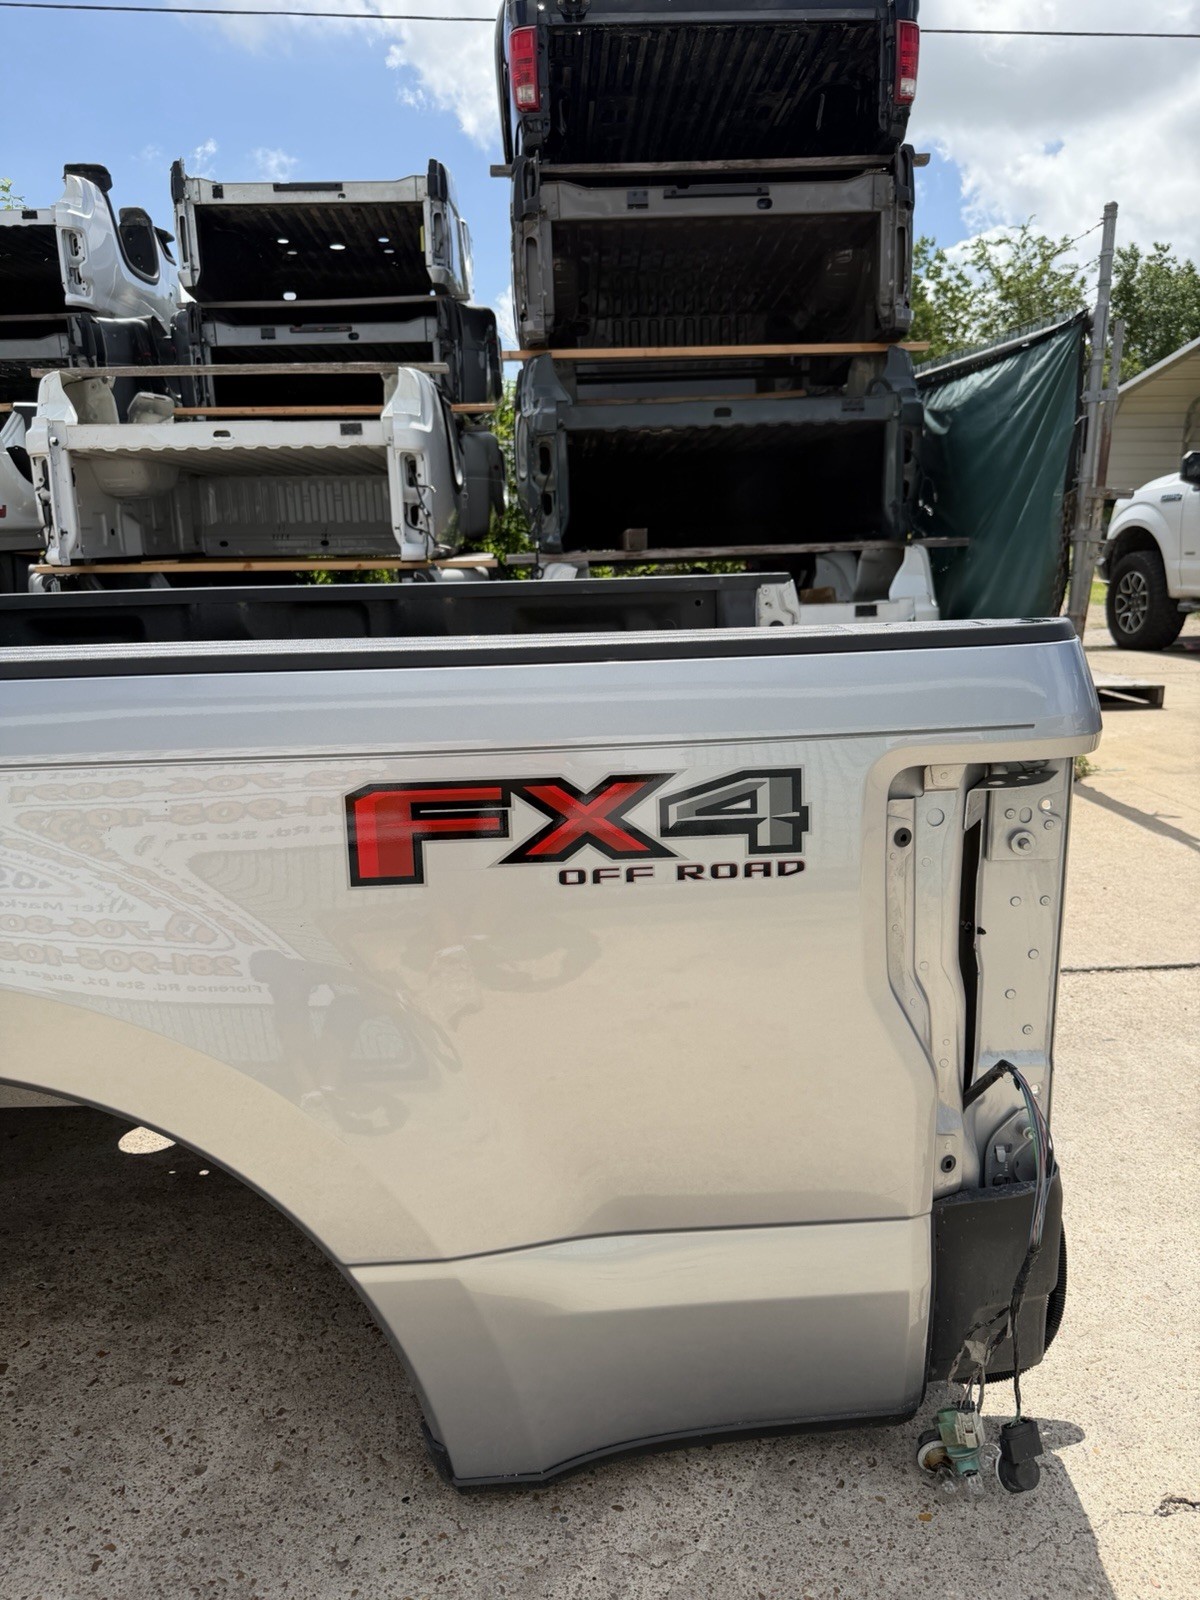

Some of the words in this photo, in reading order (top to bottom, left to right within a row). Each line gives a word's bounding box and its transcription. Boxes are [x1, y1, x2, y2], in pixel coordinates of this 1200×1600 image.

[344, 767, 810, 887] FX4
[558, 866, 654, 886] OFF
[676, 859, 806, 881] ROAD
